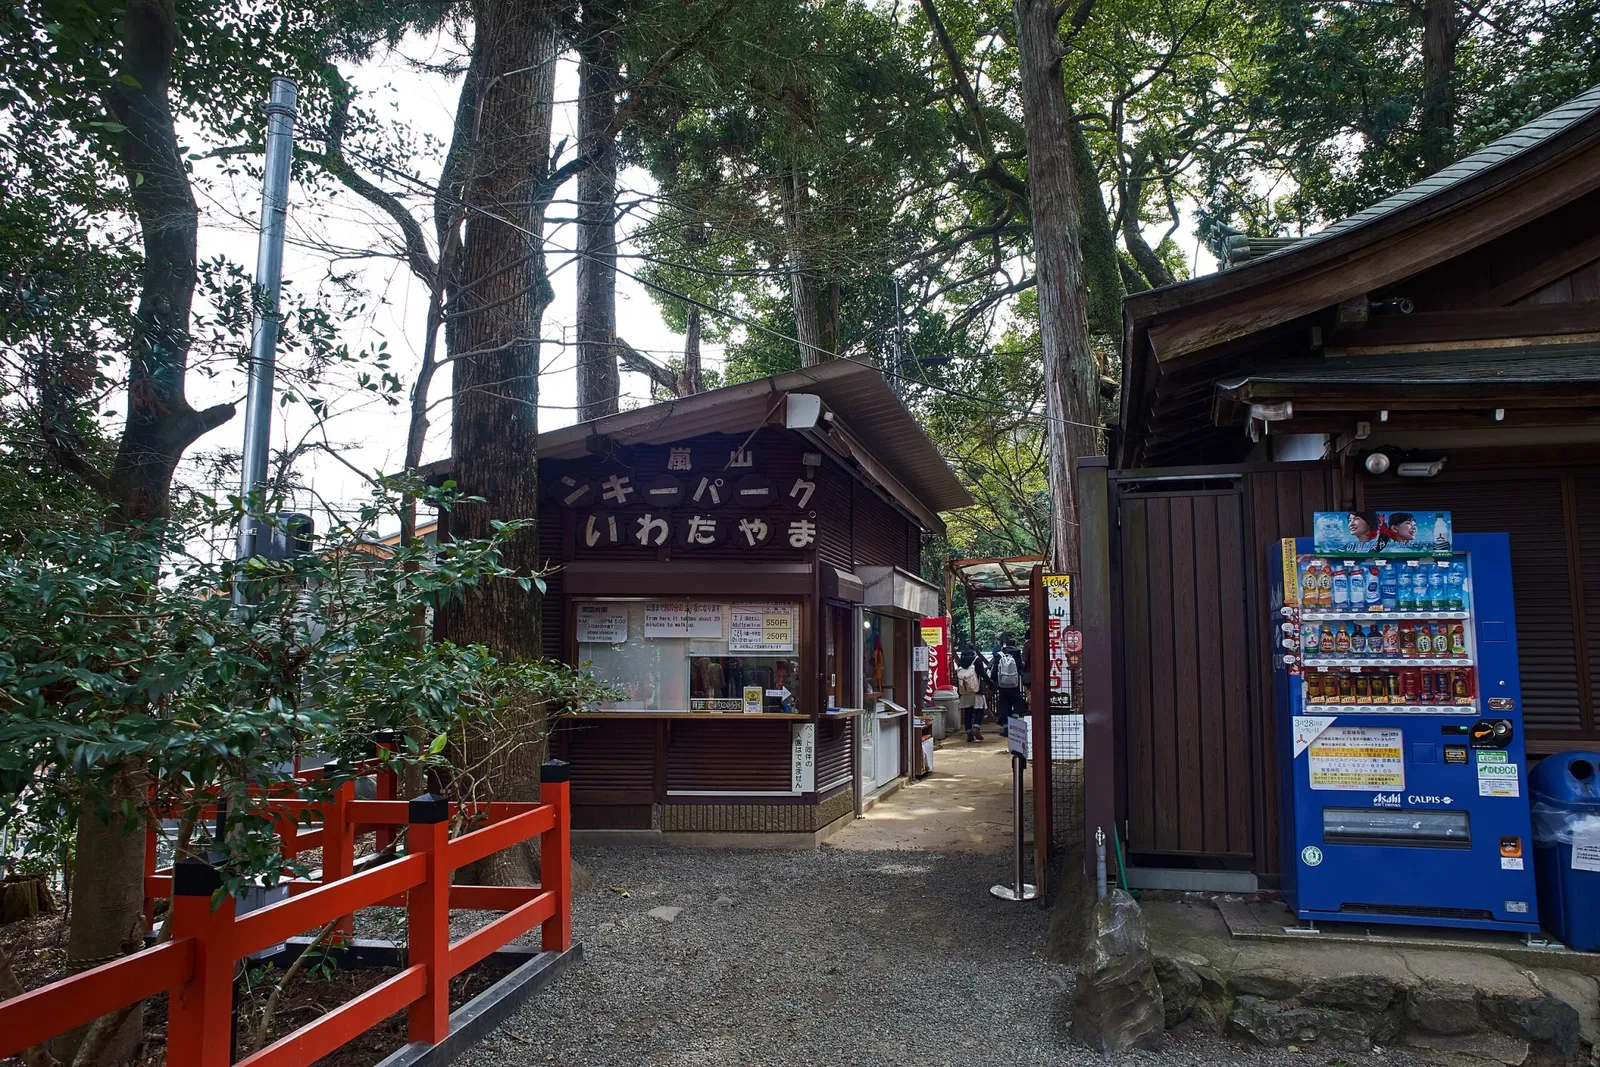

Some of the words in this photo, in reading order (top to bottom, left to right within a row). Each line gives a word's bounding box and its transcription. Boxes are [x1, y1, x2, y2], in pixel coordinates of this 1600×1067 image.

[561, 474, 816, 509] ンキーパーク
[585, 513, 817, 547] いわたやま
[1042, 578, 1069, 589] ELCOME
[766, 618, 788, 627] 550円
[766, 632, 788, 640] 250円
[804, 724, 812, 768] ペット同伴の
[1373, 792, 1401, 804] Asahi
[1408, 796, 1440, 804] CALPIS
